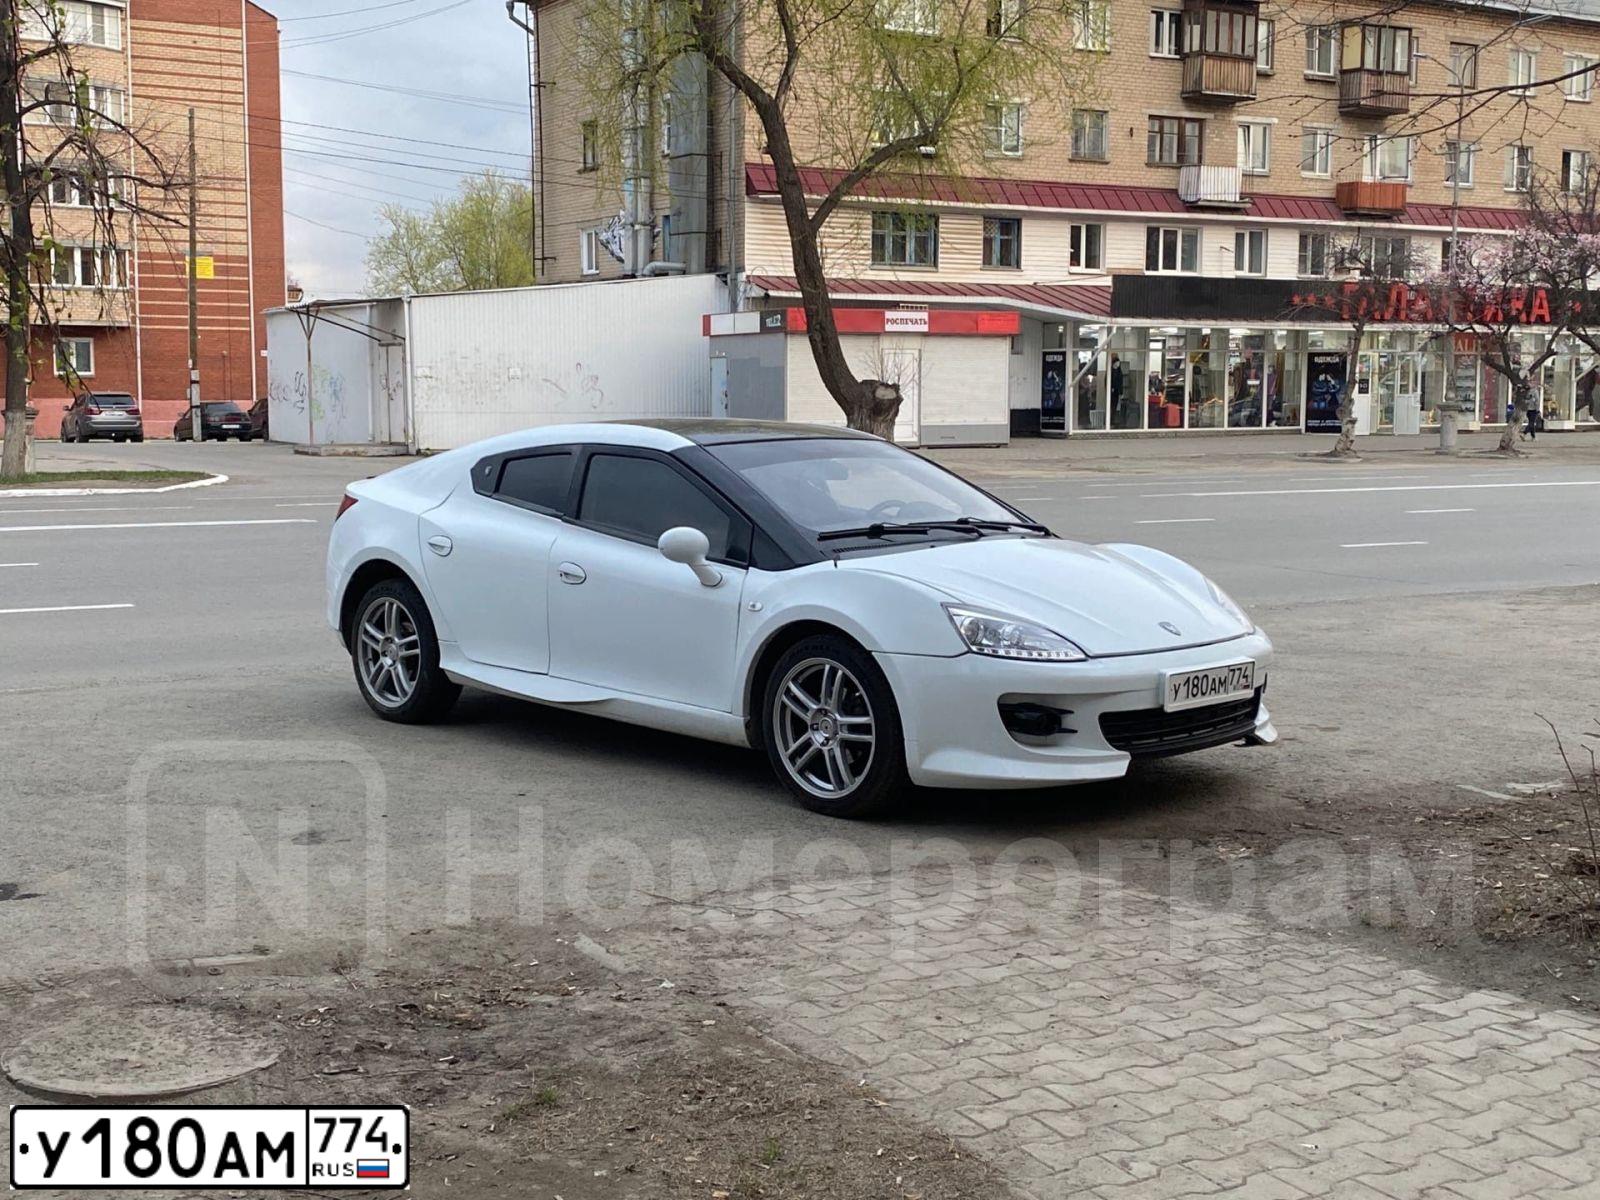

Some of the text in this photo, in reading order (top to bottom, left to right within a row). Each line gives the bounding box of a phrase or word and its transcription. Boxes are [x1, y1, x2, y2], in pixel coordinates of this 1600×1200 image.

[1342, 283, 1551, 322] ГАЛАИКА
[886, 317, 928, 326] РОСПЕЧАТЬ
[1229, 666, 1249, 686] 774
